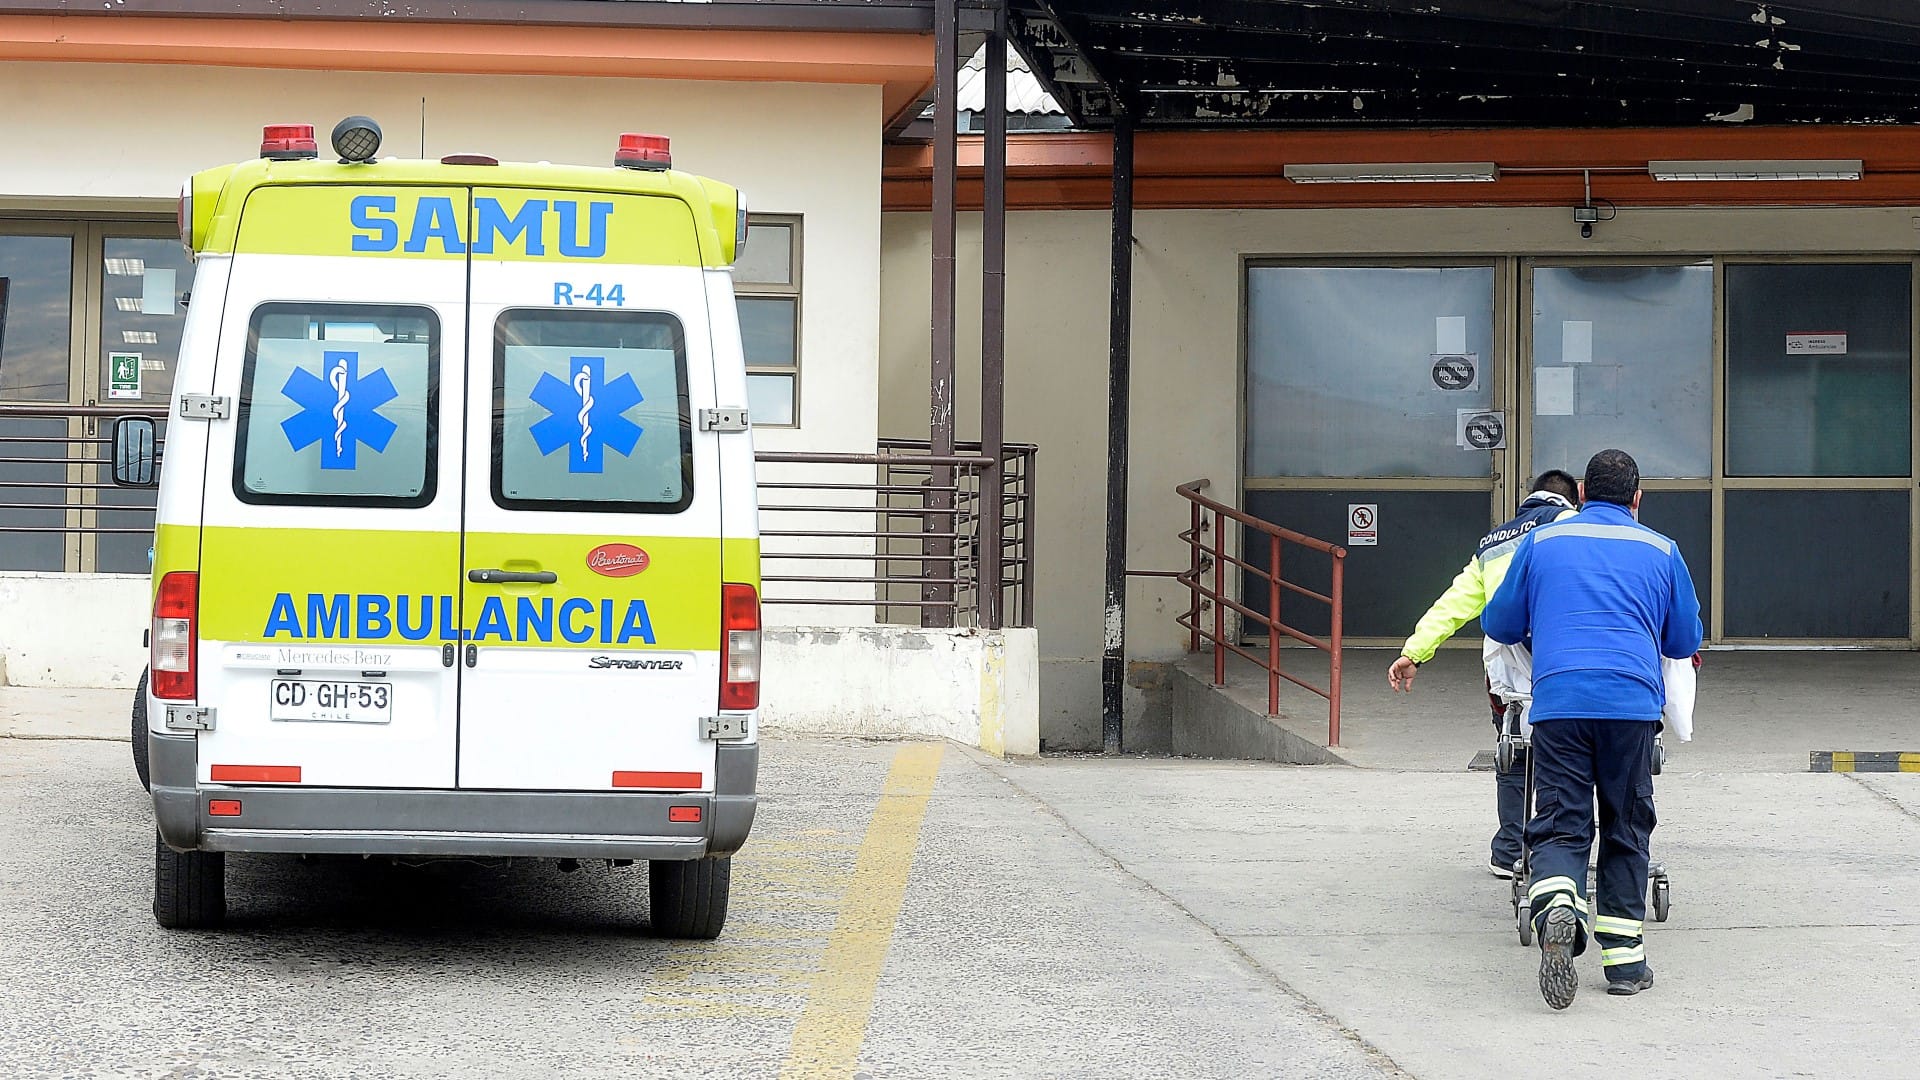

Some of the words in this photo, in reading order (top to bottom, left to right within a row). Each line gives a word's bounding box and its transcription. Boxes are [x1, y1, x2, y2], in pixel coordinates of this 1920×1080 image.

[350, 195, 614, 258] SAMU
[553, 282, 626, 307] R-44
[263, 593, 656, 645] AMBULANCIA
[311, 711, 351, 720] CHILE
